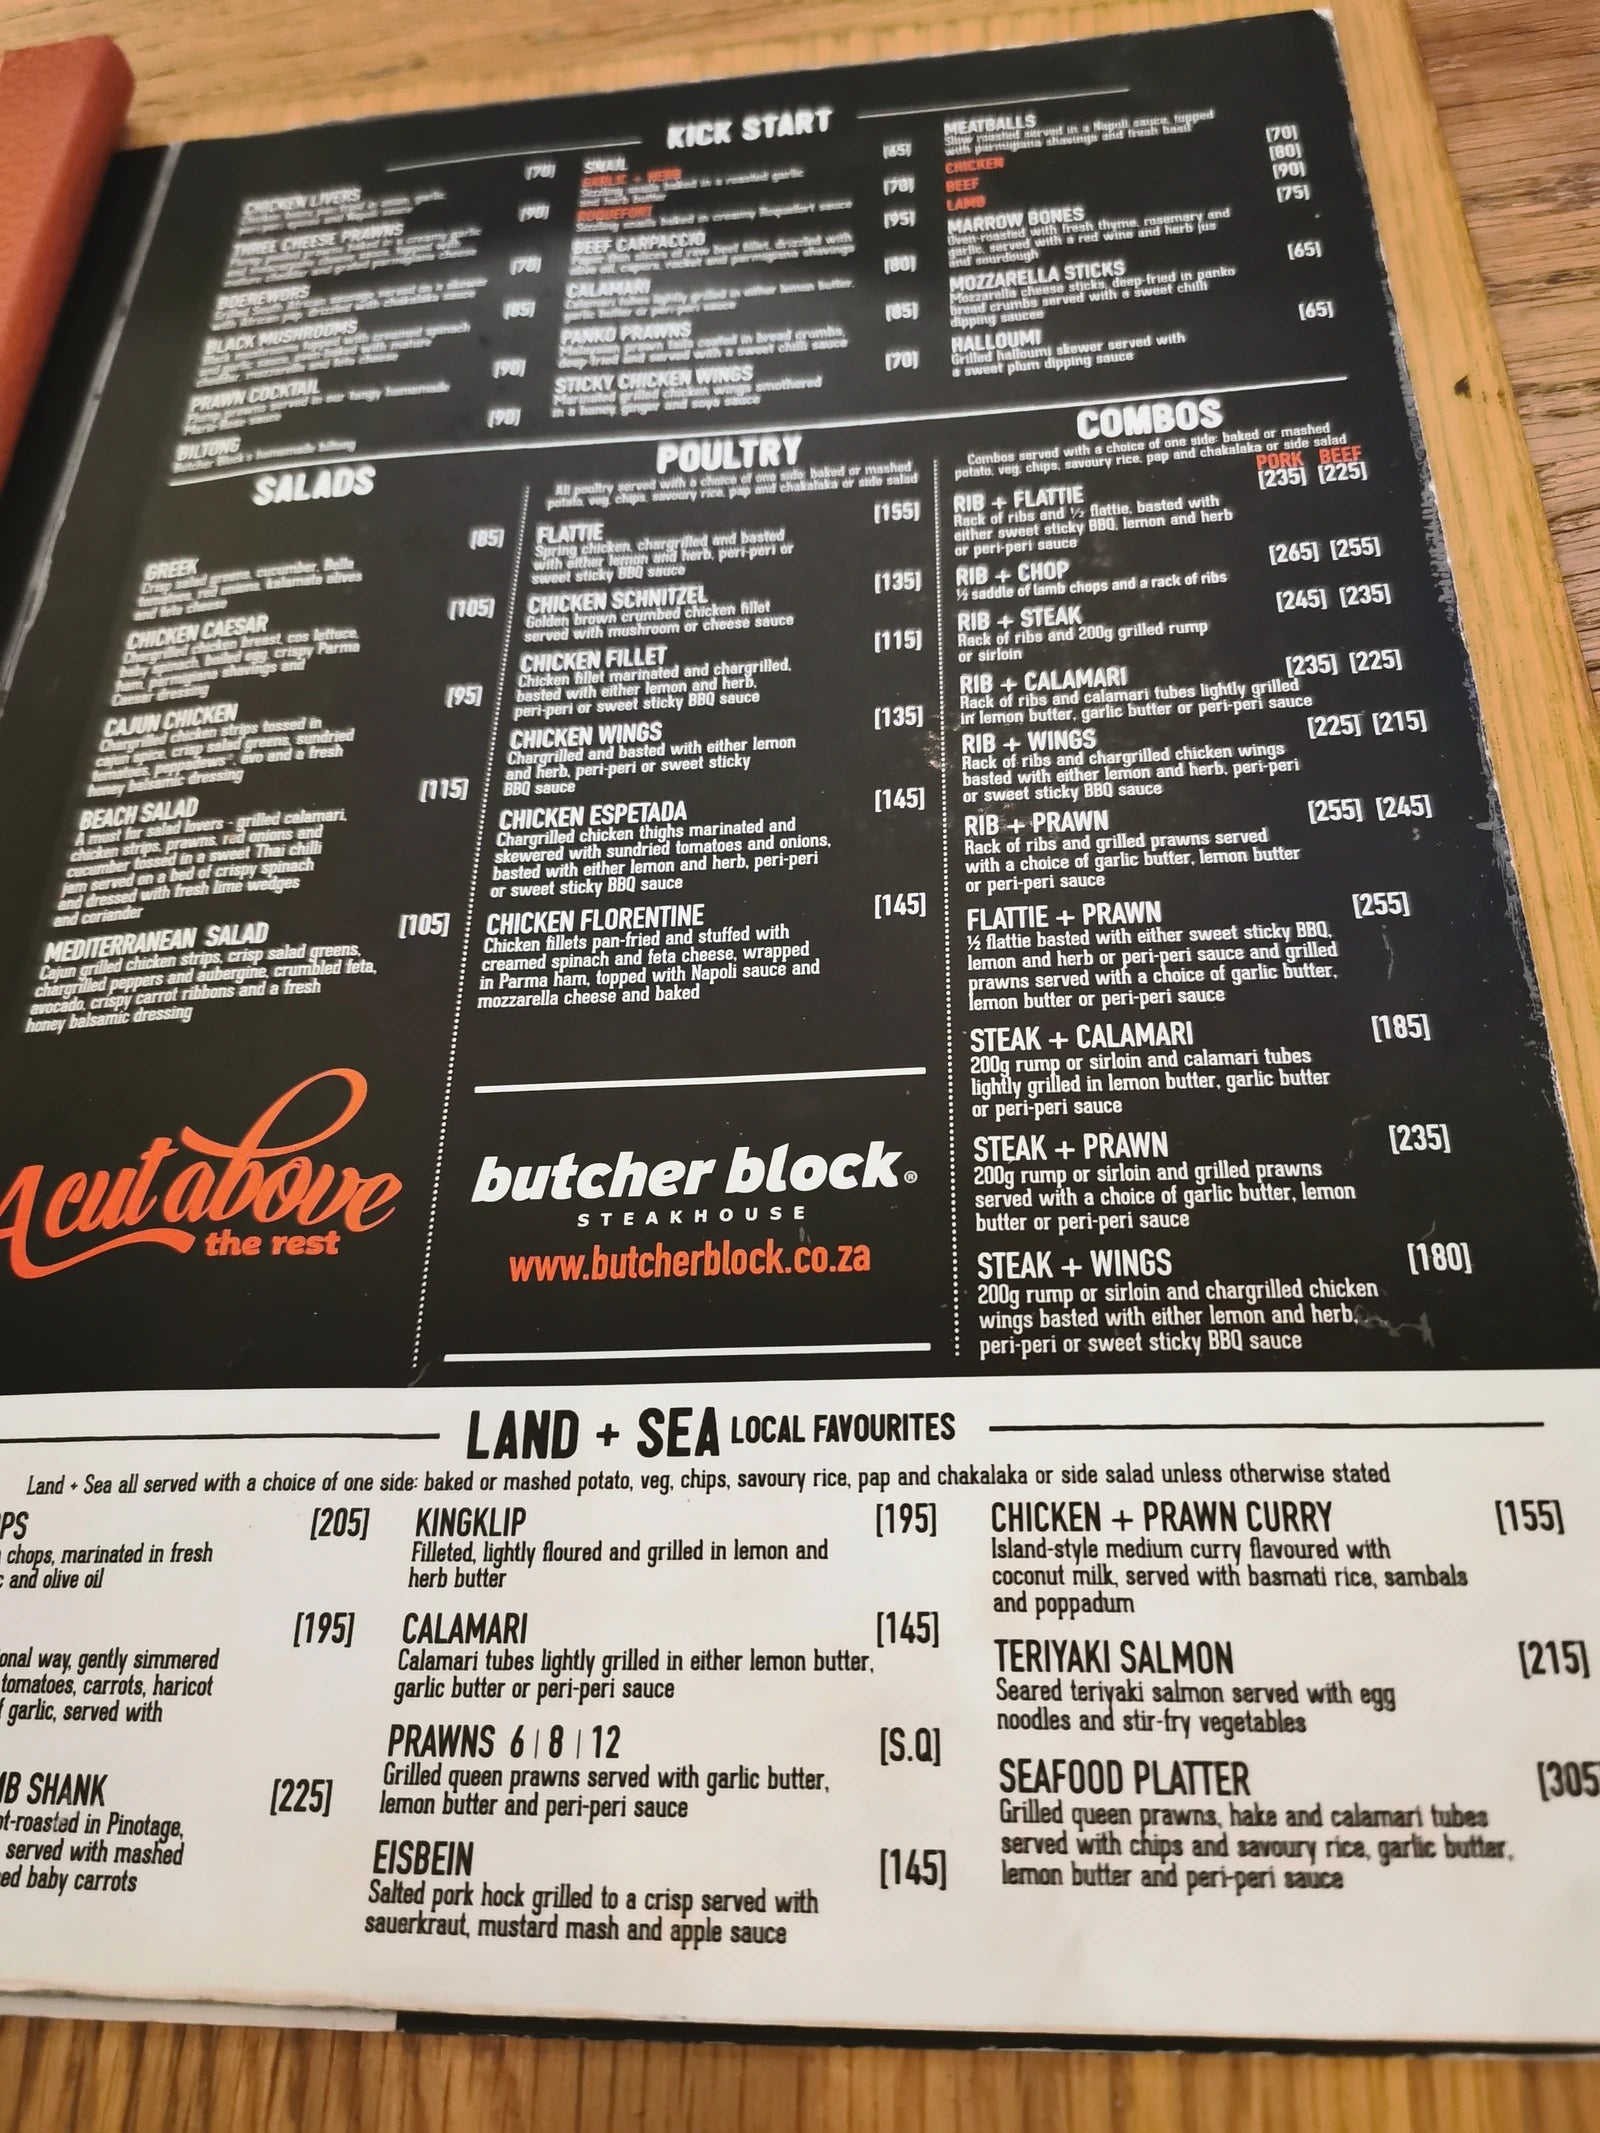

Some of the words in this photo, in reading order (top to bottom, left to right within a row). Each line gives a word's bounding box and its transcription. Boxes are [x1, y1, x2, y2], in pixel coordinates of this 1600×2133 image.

[666, 119, 733, 150] KICK
[741, 106, 833, 141] START
[943, 113, 1037, 135] MEATBALLS
[1265, 124, 1299, 143] [70]
[944, 155, 1005, 174] CHICKEN
[1268, 142, 1302, 162] [80]
[1272, 161, 1306, 180] [90]
[1276, 183, 1311, 203] [75]
[947, 212, 1024, 234] MARROW
[1027, 207, 1085, 226] BONES
[1287, 240, 1322, 261] [65]
[949, 266, 1060, 292] MOZZARELLA
[1063, 260, 1126, 281] STICKS
[1298, 300, 1335, 321] [65]
[951, 328, 1042, 352] HALLOUMI
[951, 345, 996, 366] Grilled
[996, 343, 1053, 362] halloumi
[1056, 341, 1104, 356] skewer
[1107, 334, 1152, 351] served
[1155, 331, 1186, 346] with
[951, 367, 961, 378] a
[964, 361, 1005, 377] sweet
[1006, 359, 1041, 376] plum
[1044, 354, 1093, 372] dipping
[1095, 351, 1134, 364] sauce
[1076, 397, 1224, 440] COMBOS
[656, 433, 803, 475] POULTRY
[1255, 450, 1305, 472] PORK
[1318, 445, 1362, 465] BEEF
[252, 465, 377, 507] SALADS
[873, 500, 921, 525] [155]
[535, 521, 605, 546] FLATTIE
[1329, 536, 1382, 561] [255]
[1268, 541, 1320, 566] [265]
[955, 564, 989, 587] RIB
[1017, 559, 1070, 582] CHOP
[447, 596, 496, 621] [105]
[1275, 588, 1328, 613] [245]
[1338, 583, 1392, 609] [235]
[125, 623, 201, 650] CHICKEN
[200, 613, 270, 640] CAESAR
[957, 609, 991, 633] RIB
[1020, 605, 1083, 628] STEAK
[957, 631, 992, 648] Rack
[996, 630, 1010, 646] of
[1014, 629, 1044, 645] ribs
[1047, 626, 1076, 642] and
[1078, 624, 1114, 643] 200g
[1117, 621, 1165, 642] grilled
[1168, 621, 1209, 637] rump
[874, 628, 923, 654] [115]
[958, 651, 974, 663] or
[978, 646, 1023, 662] sirloin
[519, 649, 602, 674] CHICKEN
[604, 643, 668, 668] FILLET
[445, 684, 484, 709] [95]
[103, 713, 162, 738] CAJUN
[162, 702, 239, 731] CHICKEN
[418, 776, 470, 803] [115]
[874, 786, 925, 813] [145]
[78, 804, 139, 830] BEACH
[138, 797, 200, 823] SALAD
[498, 805, 585, 831] CHICKEN
[589, 799, 688, 826] ESPETADA
[489, 886, 507, 899] or
[510, 880, 555, 897] sweet
[559, 878, 603, 898] sticky
[607, 875, 636, 893] BBQ
[640, 877, 684, 891] sauce
[486, 909, 575, 936] CHICKEN
[580, 903, 705, 932] FLORENTINE
[874, 891, 927, 920] [145]
[398, 912, 451, 940] [105]
[43, 927, 198, 964] MEDITERRANEAN
[204, 921, 270, 948] SALAD
[476, 989, 559, 1009] mozzarella
[563, 987, 617, 1005] cheese
[621, 984, 650, 1003] and
[654, 982, 701, 1002] baked
[24, 1017, 67, 1034] honey
[67, 1010, 131, 1030] balsamic
[132, 1005, 194, 1024] dressing
[1371, 1013, 1431, 1043] [185]
[969, 1026, 1042, 1053] STEAK
[1076, 1020, 1194, 1049] CALAMARI
[971, 1104, 990, 1118] or
[995, 1098, 1068, 1121] peri-peri
[1073, 1100, 1123, 1115] sauce
[44, 1137, 179, 1239] cut
[162, 1067, 403, 1232] above
[470, 1151, 717, 1203] butcher
[724, 1140, 902, 1194] block
[577, 1205, 806, 1228] STEAKHOUSE
[205, 1228, 261, 1257] the
[271, 1230, 341, 1255] rest
[509, 1238, 871, 1283] www.butcherblock.co.za
[977, 1250, 1053, 1280] STEAK
[1090, 1247, 1173, 1277] WINGS
[1407, 1242, 1472, 1276] [180]
[466, 1409, 580, 1460] LAND
[636, 1406, 720, 1459] SEA
[731, 1414, 806, 1444] LOCAL
[813, 1412, 956, 1443] FAVOURITES
[309, 1507, 371, 1541] [205]
[415, 1506, 527, 1538] KINGKLIP
[876, 1502, 937, 1538] [195]
[991, 1501, 1101, 1533] CHICKEN
[1143, 1500, 1238, 1532] PRAWN
[1246, 1500, 1332, 1533] CURRY
[1495, 1499, 1565, 1536] [155]
[407, 1566, 448, 1588] herb
[453, 1566, 508, 1588] butter
[293, 1611, 356, 1648] [195]
[402, 1612, 528, 1645] CALAMARI
[877, 1611, 939, 1649] [145]
[997, 1638, 1111, 1674] TERIYAKI
[1120, 1640, 1234, 1675] SALMON
[1518, 1640, 1590, 1680] [215]
[387, 1723, 496, 1758] PRAWNS
[510, 1724, 525, 1759] 6
[548, 1724, 564, 1759] 8
[592, 1724, 621, 1759] 12
[880, 1726, 941, 1767] [S.Q]
[26, 1771, 109, 1807] SHANK
[999, 1758, 1124, 1795] SEAFOOD
[1133, 1759, 1251, 1797] PLATTER
[1537, 1761, 1600, 1802] [305
[269, 1778, 334, 1818] [225]
[372, 1839, 474, 1877] EISBEIN
[880, 1848, 947, 1891] [145]
